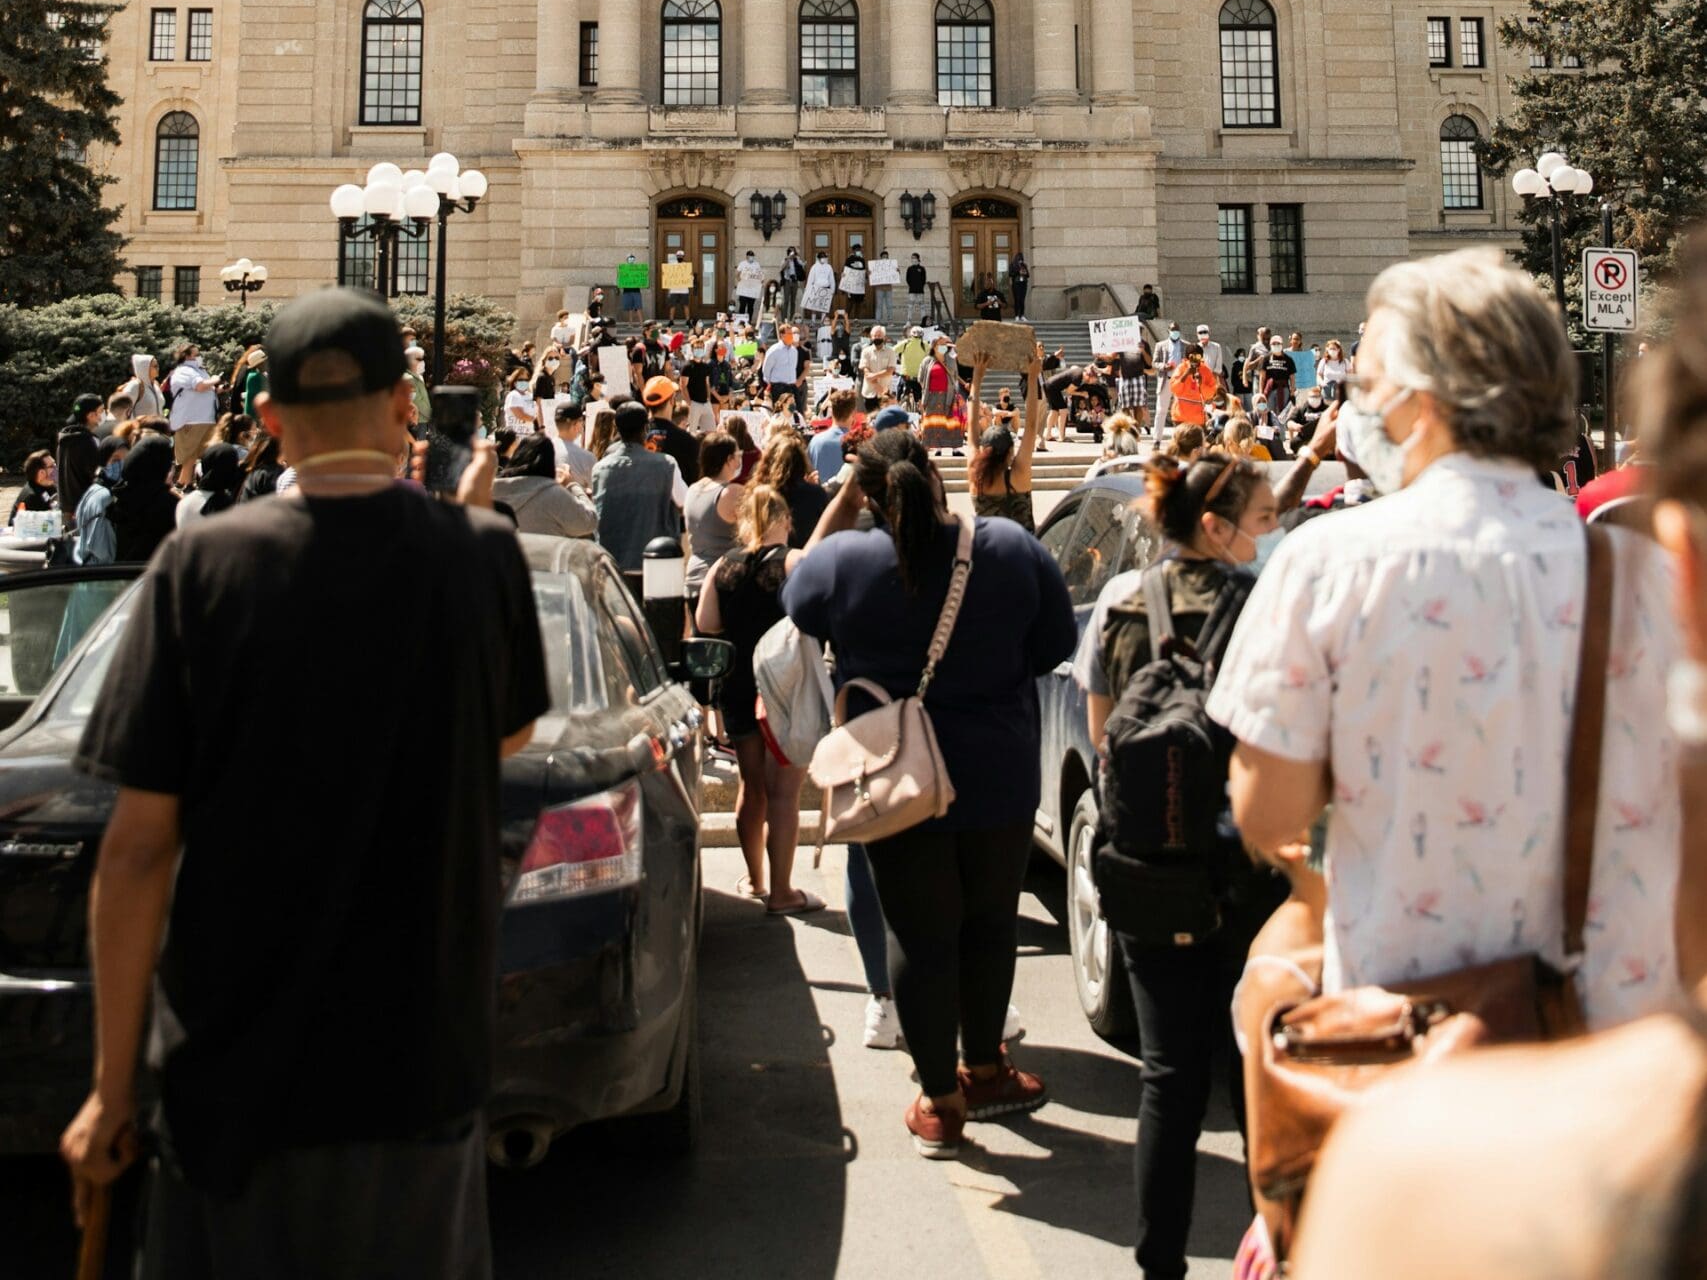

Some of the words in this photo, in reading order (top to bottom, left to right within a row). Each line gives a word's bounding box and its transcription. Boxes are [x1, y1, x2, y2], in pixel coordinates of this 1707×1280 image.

[1590, 290, 1632, 303] Except
[1597, 303, 1624, 315] MLA
[1093, 321, 1107, 333] MY
[1563, 460, 1580, 497] 1
